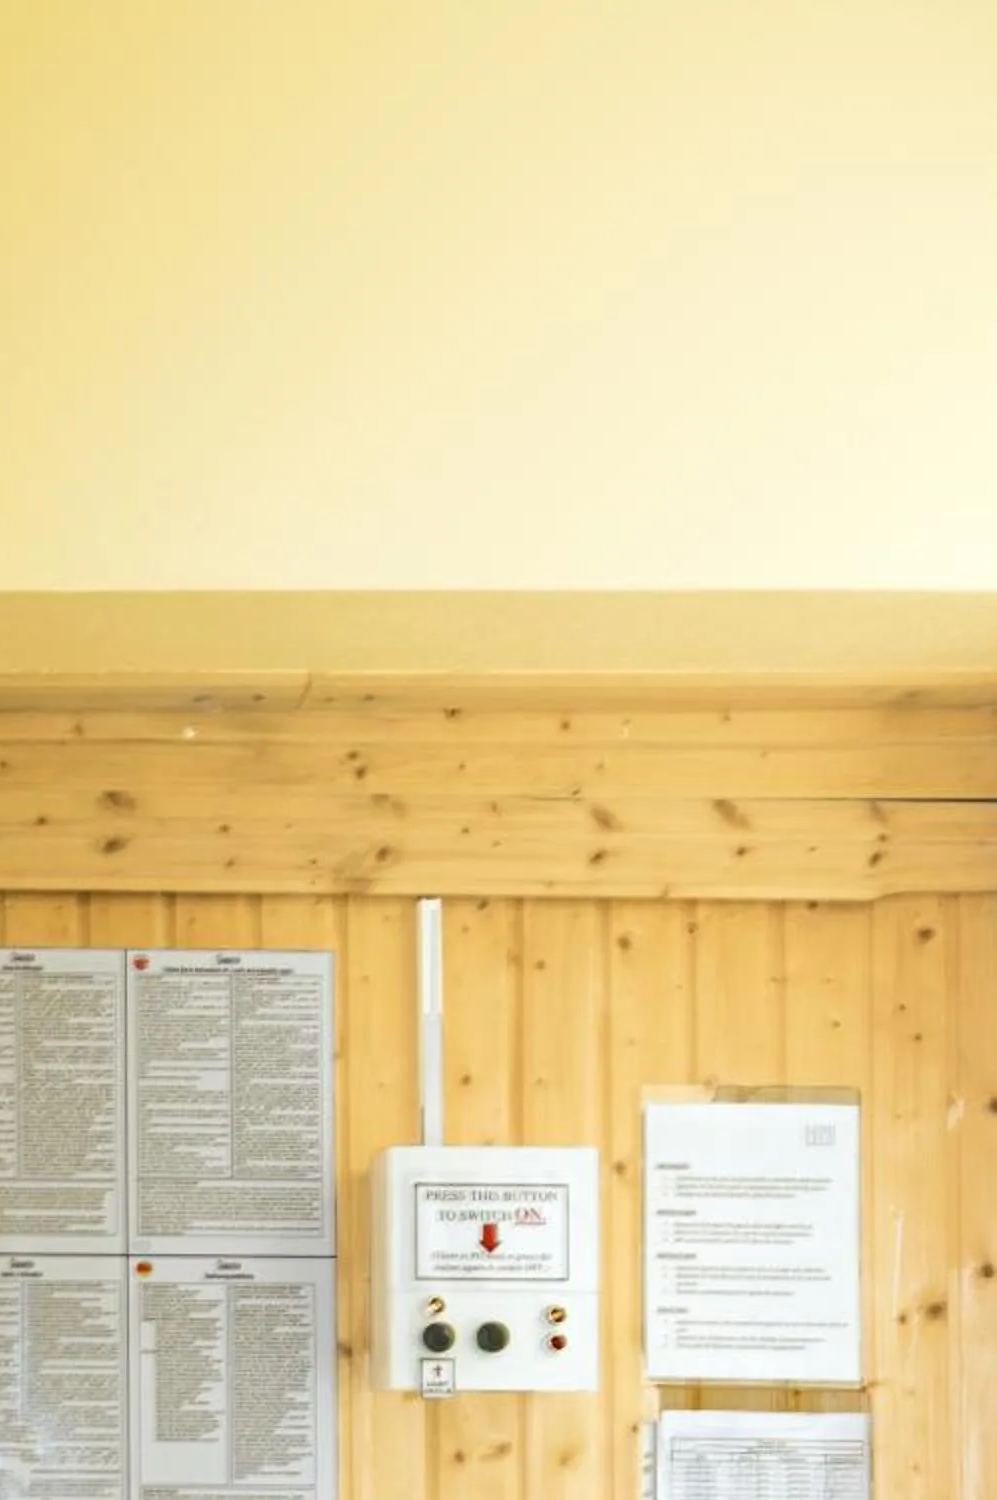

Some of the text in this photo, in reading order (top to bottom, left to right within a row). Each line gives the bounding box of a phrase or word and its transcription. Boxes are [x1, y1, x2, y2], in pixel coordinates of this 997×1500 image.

[425, 1190, 466, 1201] PRESS
[502, 1190, 558, 1202] BUTTON
[439, 1209, 457, 1222] TO
[458, 1209, 512, 1222] SWITCH
